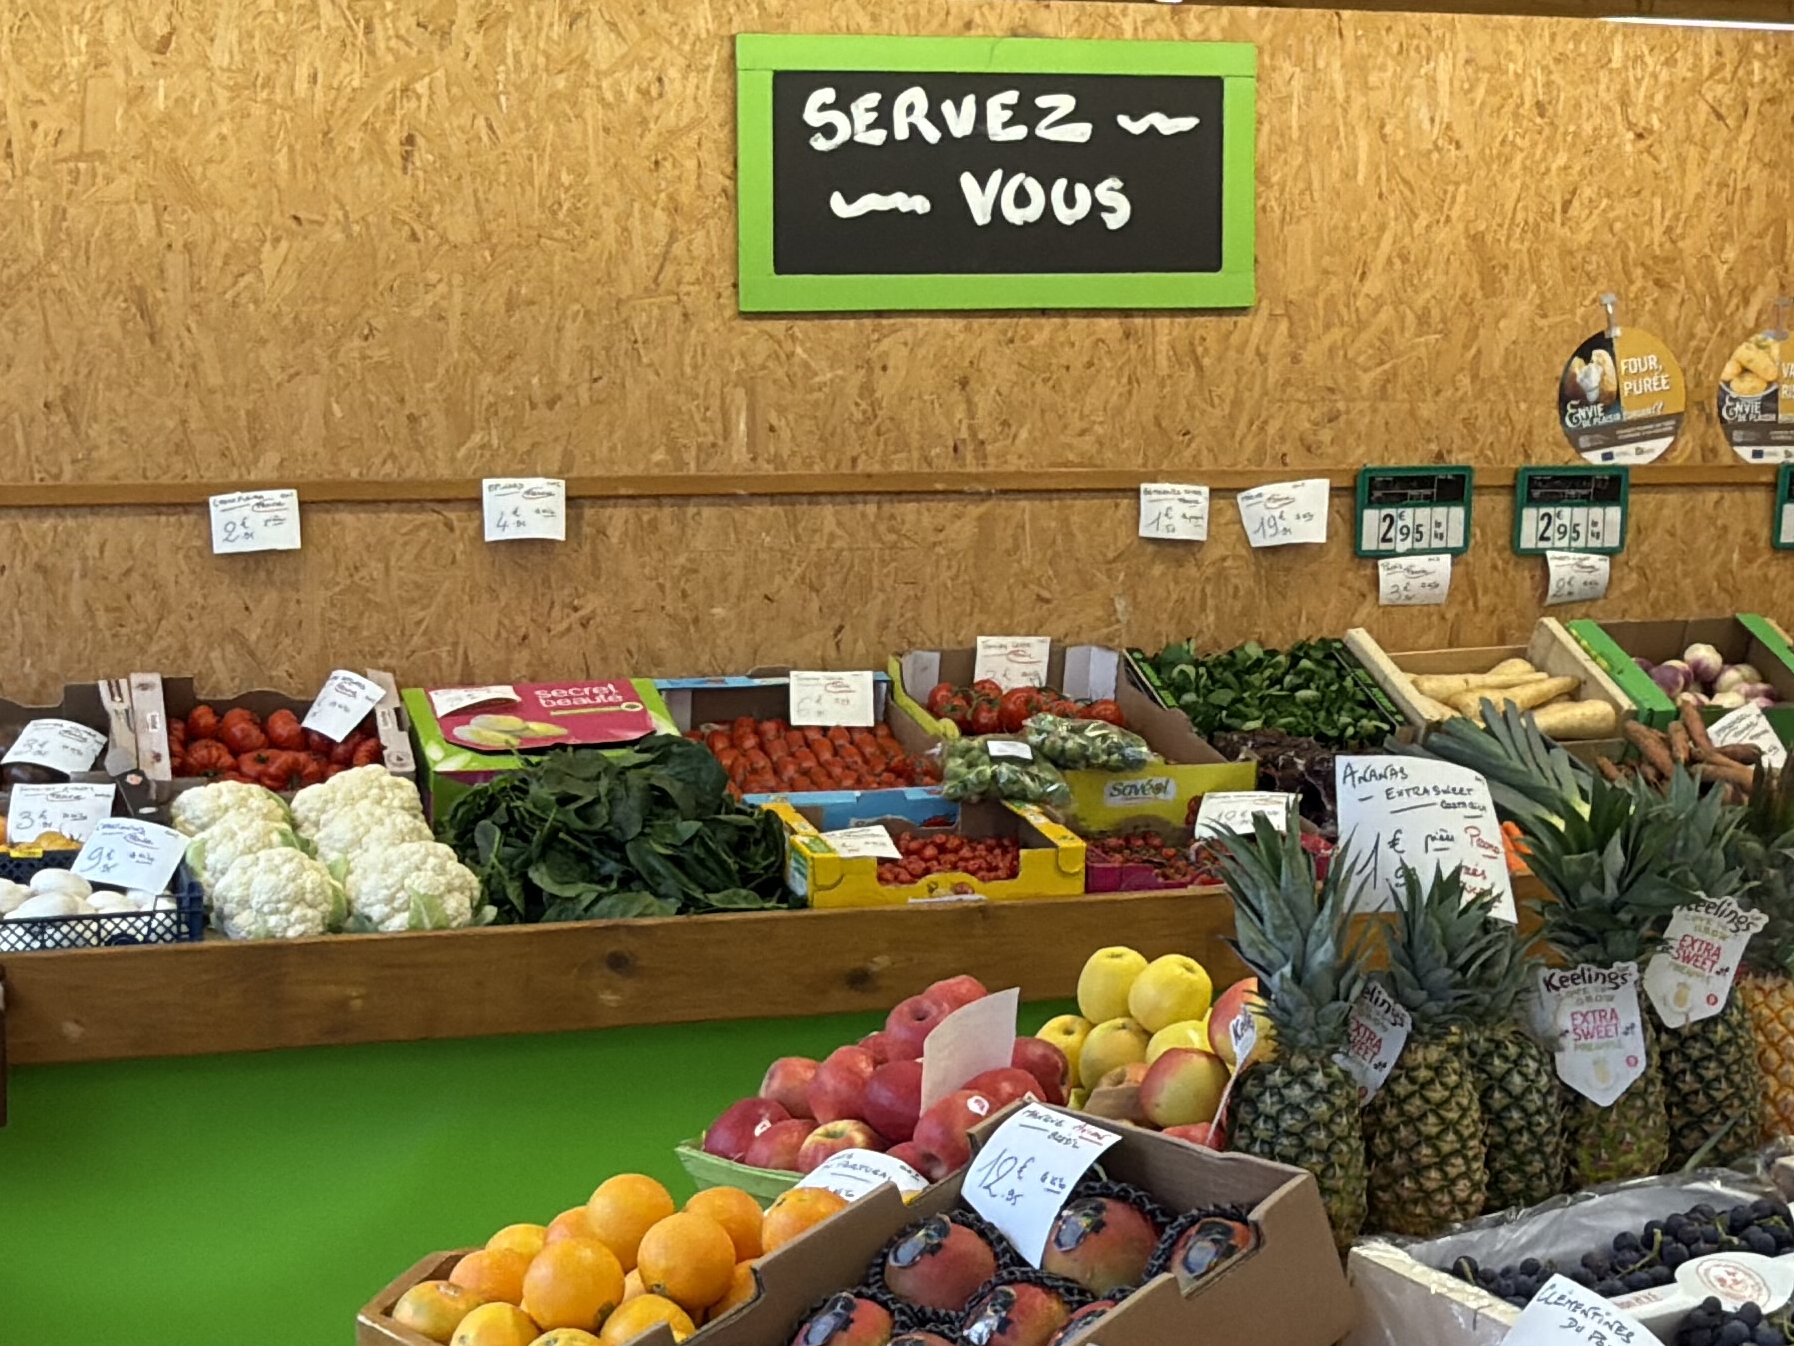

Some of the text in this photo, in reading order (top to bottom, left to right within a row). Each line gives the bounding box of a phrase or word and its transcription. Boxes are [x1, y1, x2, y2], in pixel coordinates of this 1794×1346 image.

[803, 86, 1092, 151] SERVEZ
[959, 168, 1131, 230] VOUS
[1623, 372, 1670, 396] PURÉE
[1109, 778, 1170, 797] Savéol
[1343, 762, 1408, 788] ANANAS
[1388, 829, 1405, 854] €
[1679, 934, 1722, 960] EXTRA
[1673, 948, 1718, 974] SWEET
[1543, 969, 1632, 992] Keelings
[1571, 1008, 1620, 1025] EXTRA
[1573, 1024, 1620, 1041] SWEET
